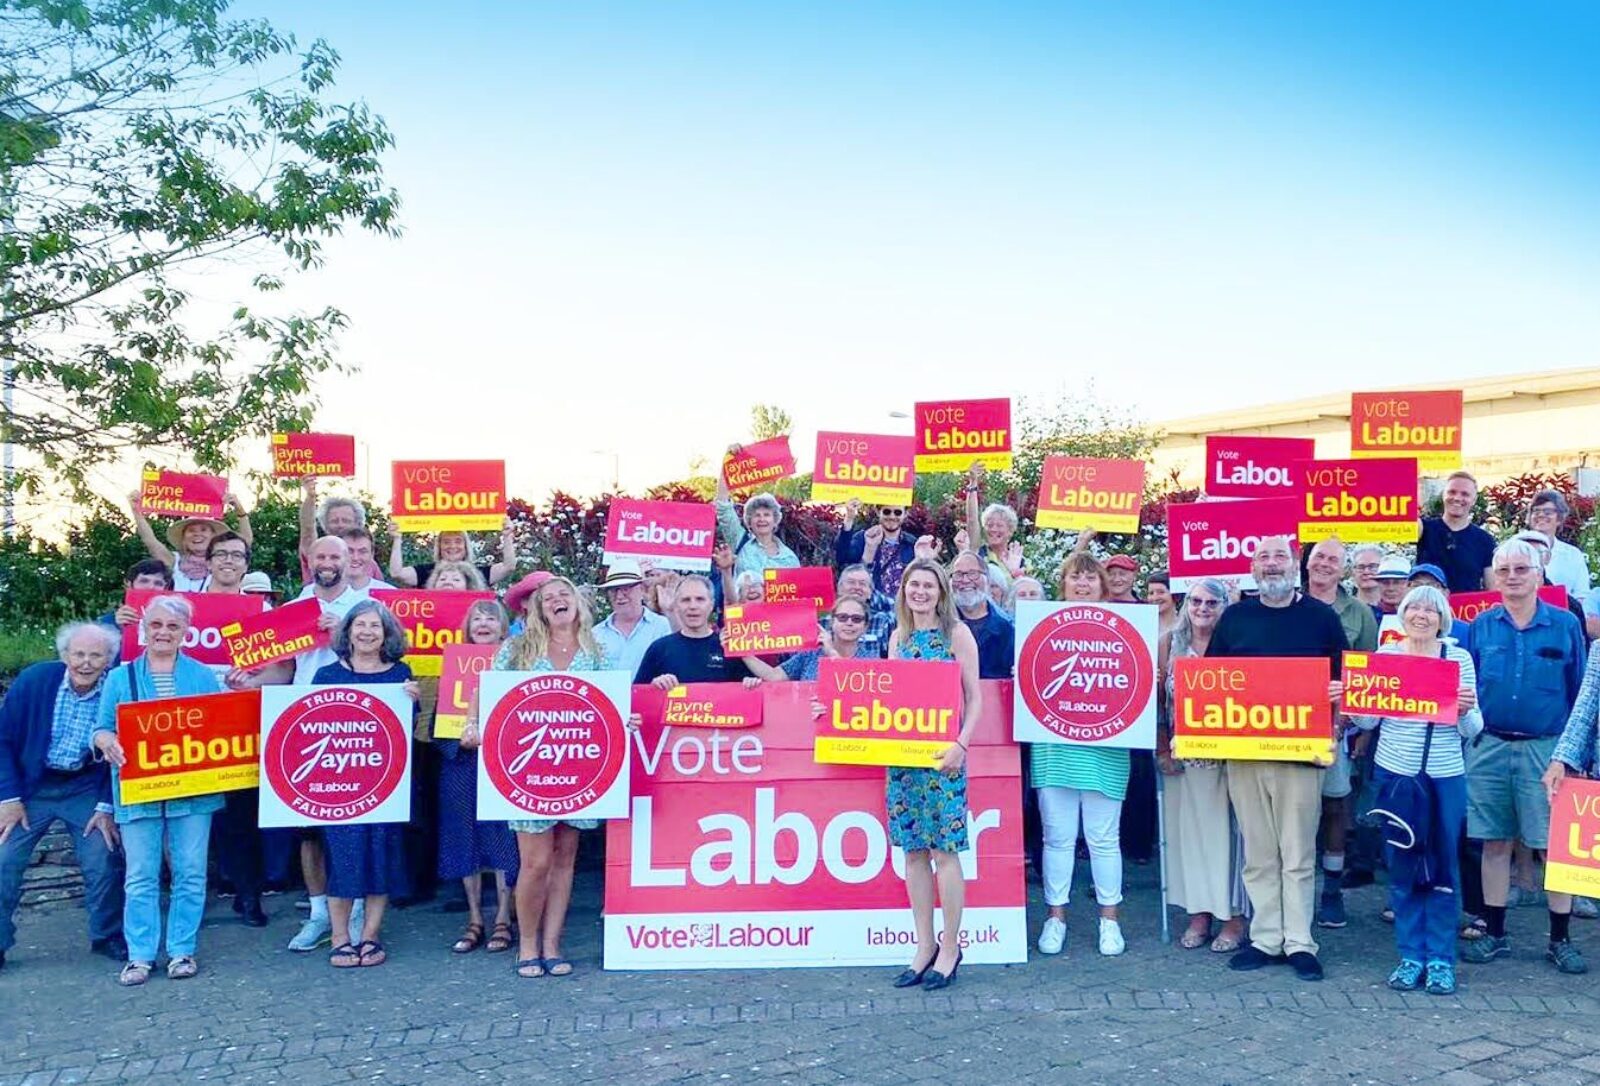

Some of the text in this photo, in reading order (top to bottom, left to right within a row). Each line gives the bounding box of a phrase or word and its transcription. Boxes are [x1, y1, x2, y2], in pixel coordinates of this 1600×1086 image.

[924, 405, 966, 425] vote
[1363, 398, 1410, 418] vote
[924, 428, 1008, 451] Labour
[1362, 421, 1459, 446] Labour
[826, 438, 869, 456] vote
[1217, 450, 1239, 460] Vote
[275, 460, 342, 474] Kirkham
[403, 466, 452, 484] vote
[728, 464, 784, 486] Kirkham
[824, 456, 909, 484] Labour
[1054, 464, 1097, 482] vote
[1216, 460, 1294, 487] Labou
[1305, 466, 1358, 487] vote
[142, 481, 184, 499] Jayne
[403, 487, 500, 511] Labour
[1051, 484, 1137, 509] Labour
[141, 496, 210, 514] Kirkham
[1305, 491, 1412, 517] Labour
[621, 510, 643, 520] Vote
[1182, 520, 1209, 531] Vote
[617, 519, 712, 547] Labour
[765, 581, 797, 597] Jayne
[726, 620, 771, 638] Jayne
[1052, 609, 1118, 628] TRURO &
[226, 627, 276, 655] Jayne
[233, 634, 314, 669] Kirkham
[728, 634, 803, 652] Kirkham
[1050, 638, 1123, 653] WINNING
[1079, 657, 1119, 669] WITH
[834, 669, 893, 693] vote
[1042, 652, 1129, 700] Jayne
[1184, 665, 1246, 691] vote
[1345, 670, 1401, 692] Jayne
[520, 678, 589, 697] TRURO &
[303, 691, 372, 709] TRURO &
[666, 699, 714, 713] Jayne
[1068, 701, 1107, 713] Labour
[1346, 690, 1438, 716] Kirkham
[137, 706, 204, 734] vote
[517, 710, 595, 723] WINNING
[665, 712, 745, 725] Kirkham
[832, 699, 953, 734] Labour
[1184, 696, 1313, 730] Labour
[300, 721, 377, 734] WINNING
[549, 728, 591, 739] WITH
[1043, 713, 1125, 739] FALMOUTH
[138, 734, 260, 770] Labou
[332, 737, 373, 748] WITH
[508, 723, 600, 775] Jayne
[633, 725, 764, 776] Vote
[291, 734, 383, 784] Jayne
[319, 782, 361, 793] Labour
[535, 774, 579, 785] Labour
[292, 794, 379, 818] FALMOUTH
[509, 788, 597, 813] FALMOUTH
[630, 788, 1000, 888] Labor
[626, 922, 814, 949] Vote Labour
